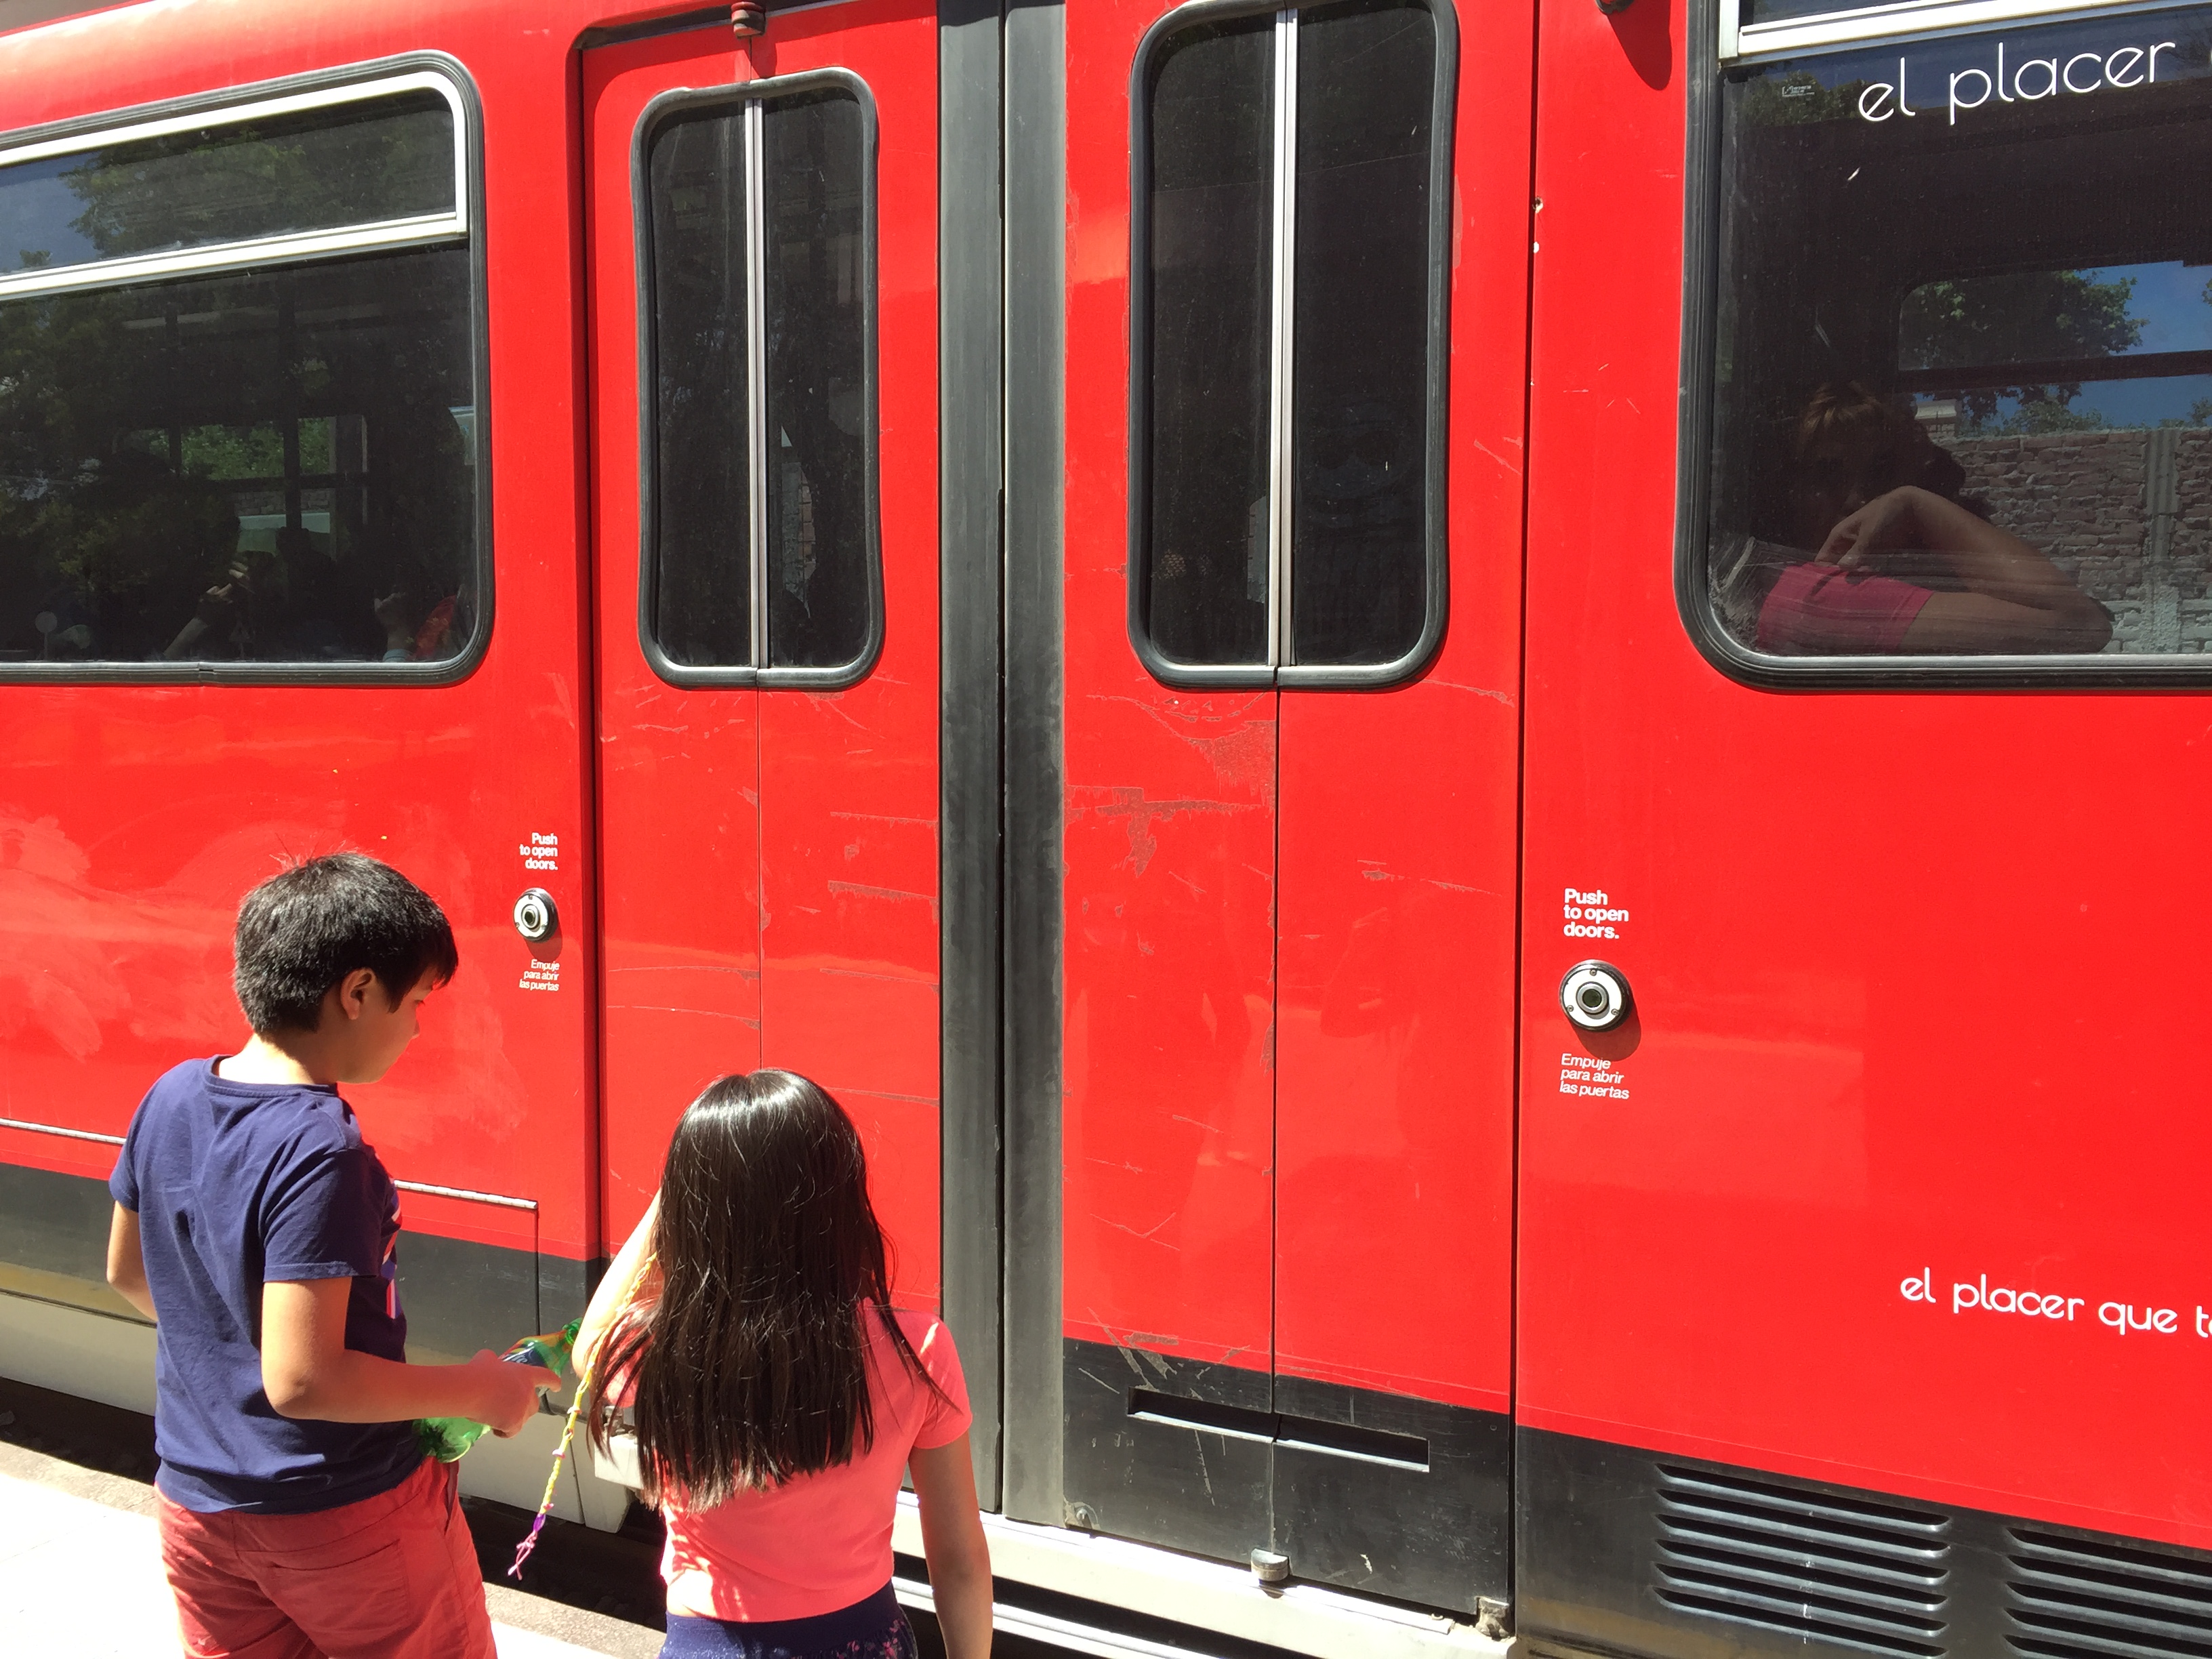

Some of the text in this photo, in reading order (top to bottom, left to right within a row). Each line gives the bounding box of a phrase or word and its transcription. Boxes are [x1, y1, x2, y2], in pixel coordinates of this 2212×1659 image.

[1859, 42, 2175, 125] el placer
[532, 832, 558, 844] Push
[519, 844, 558, 859] to open
[525, 857, 558, 870] doors.
[1565, 888, 1607, 905] Push
[1563, 904, 1629, 924] to open
[1563, 921, 1619, 939] doors.
[531, 958, 560, 972] Empuje
[524, 970, 559, 981] para abrir
[519, 979, 559, 991] las puertas
[1561, 1053, 1611, 1070] Empuje
[1560, 1069, 1624, 1084] para abrir
[1559, 1081, 1629, 1099] las puertas
[1900, 1267, 1936, 1303] el
[1953, 1273, 2085, 1321] placer
[2098, 1302, 2177, 1335] que
